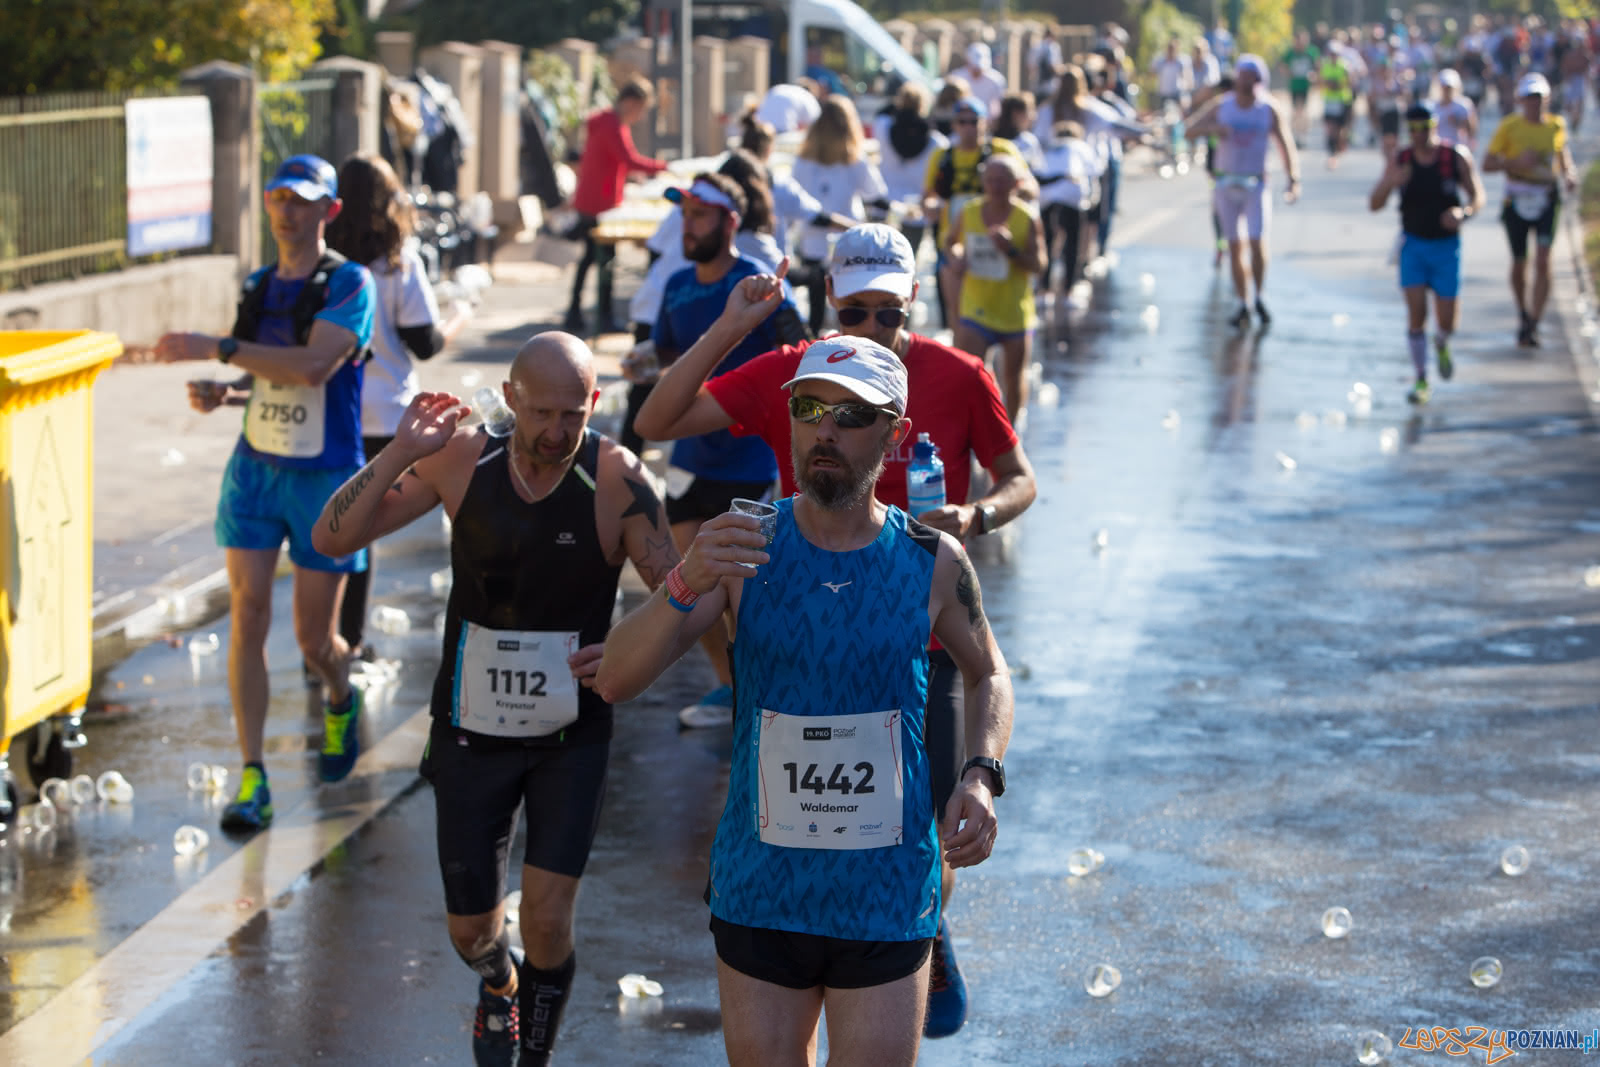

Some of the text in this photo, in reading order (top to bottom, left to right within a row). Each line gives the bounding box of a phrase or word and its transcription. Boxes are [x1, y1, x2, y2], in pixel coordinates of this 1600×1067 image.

[259, 402, 307, 426] 2750
[487, 668, 547, 697] 1112
[496, 699, 536, 711] Krzysztof
[783, 761, 875, 795] 1442
[800, 802, 859, 813] Waldemar
